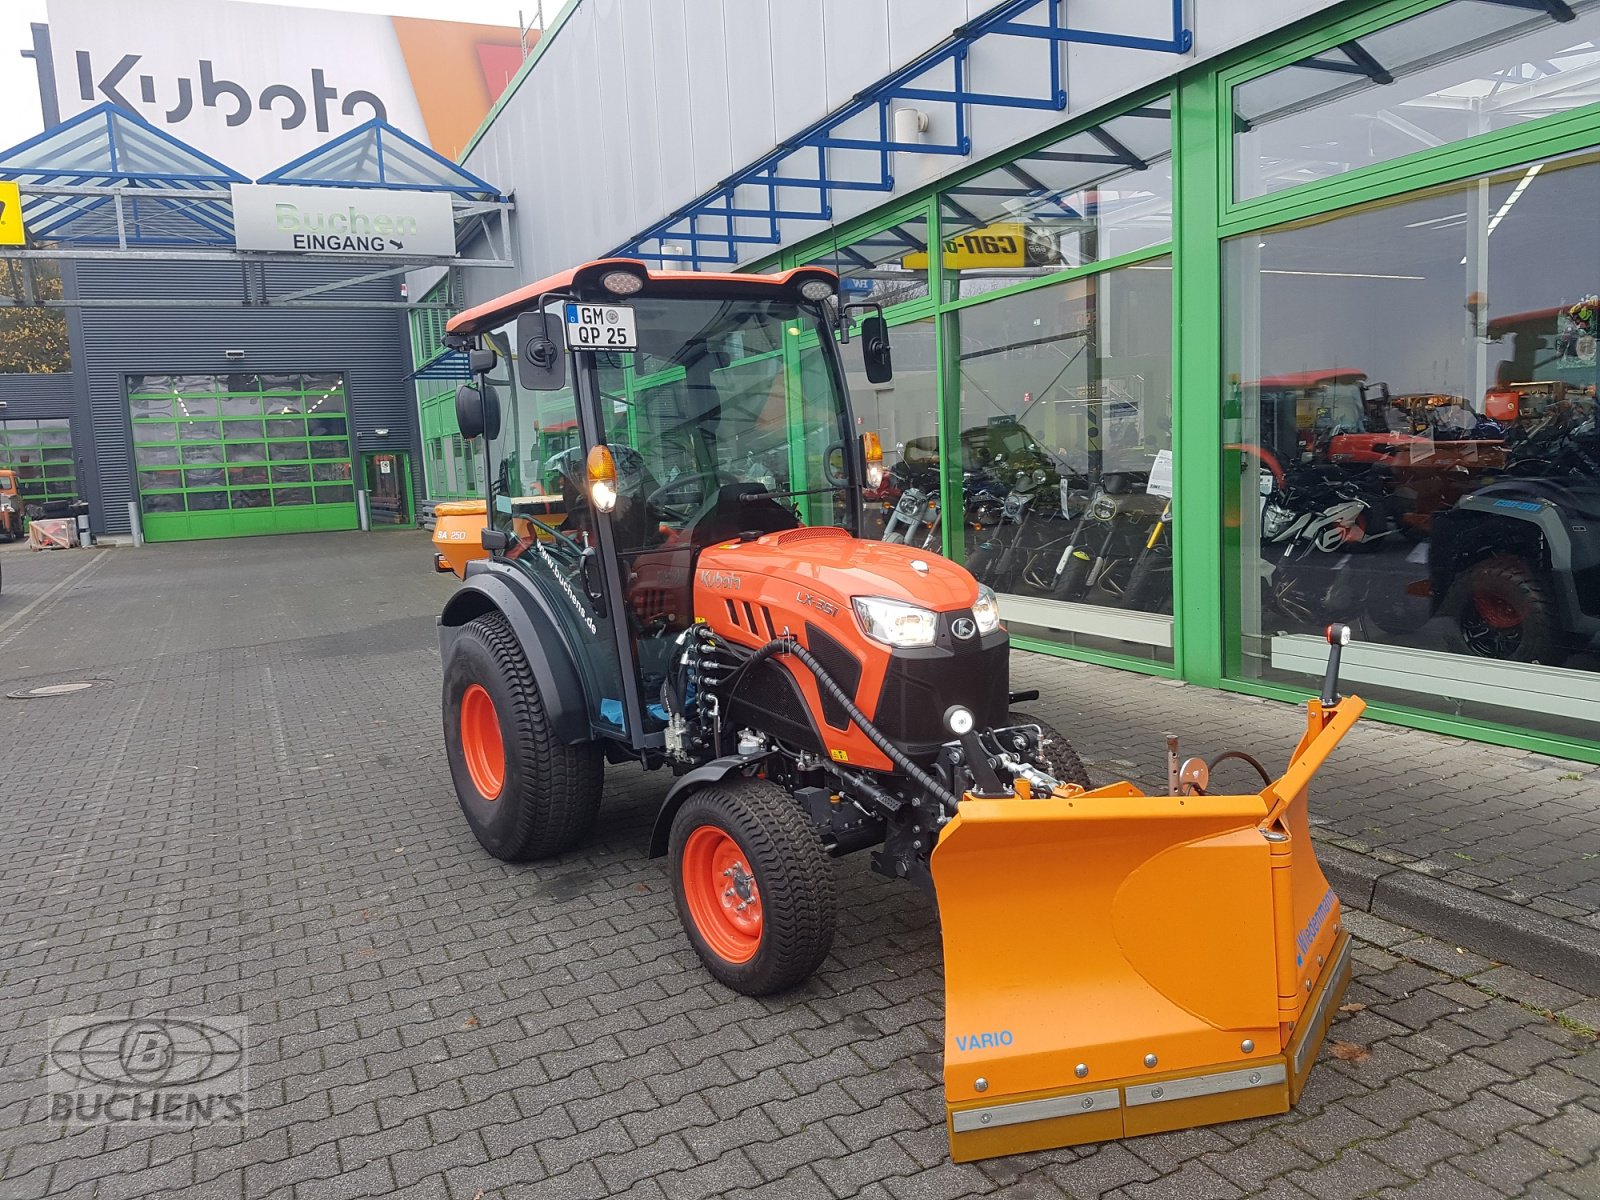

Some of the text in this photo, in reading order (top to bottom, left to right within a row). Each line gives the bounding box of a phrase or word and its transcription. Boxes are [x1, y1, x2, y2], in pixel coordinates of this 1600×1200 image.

[76, 50, 387, 132] Kubota
[276, 203, 417, 236] Buchen
[293, 234, 385, 251] EINGANG
[582, 308, 604, 325] GM
[579, 327, 627, 344] QP 25
[437, 531, 466, 540] SA 250
[701, 570, 741, 590] Kubota
[955, 1029, 1013, 1051] VARIO
